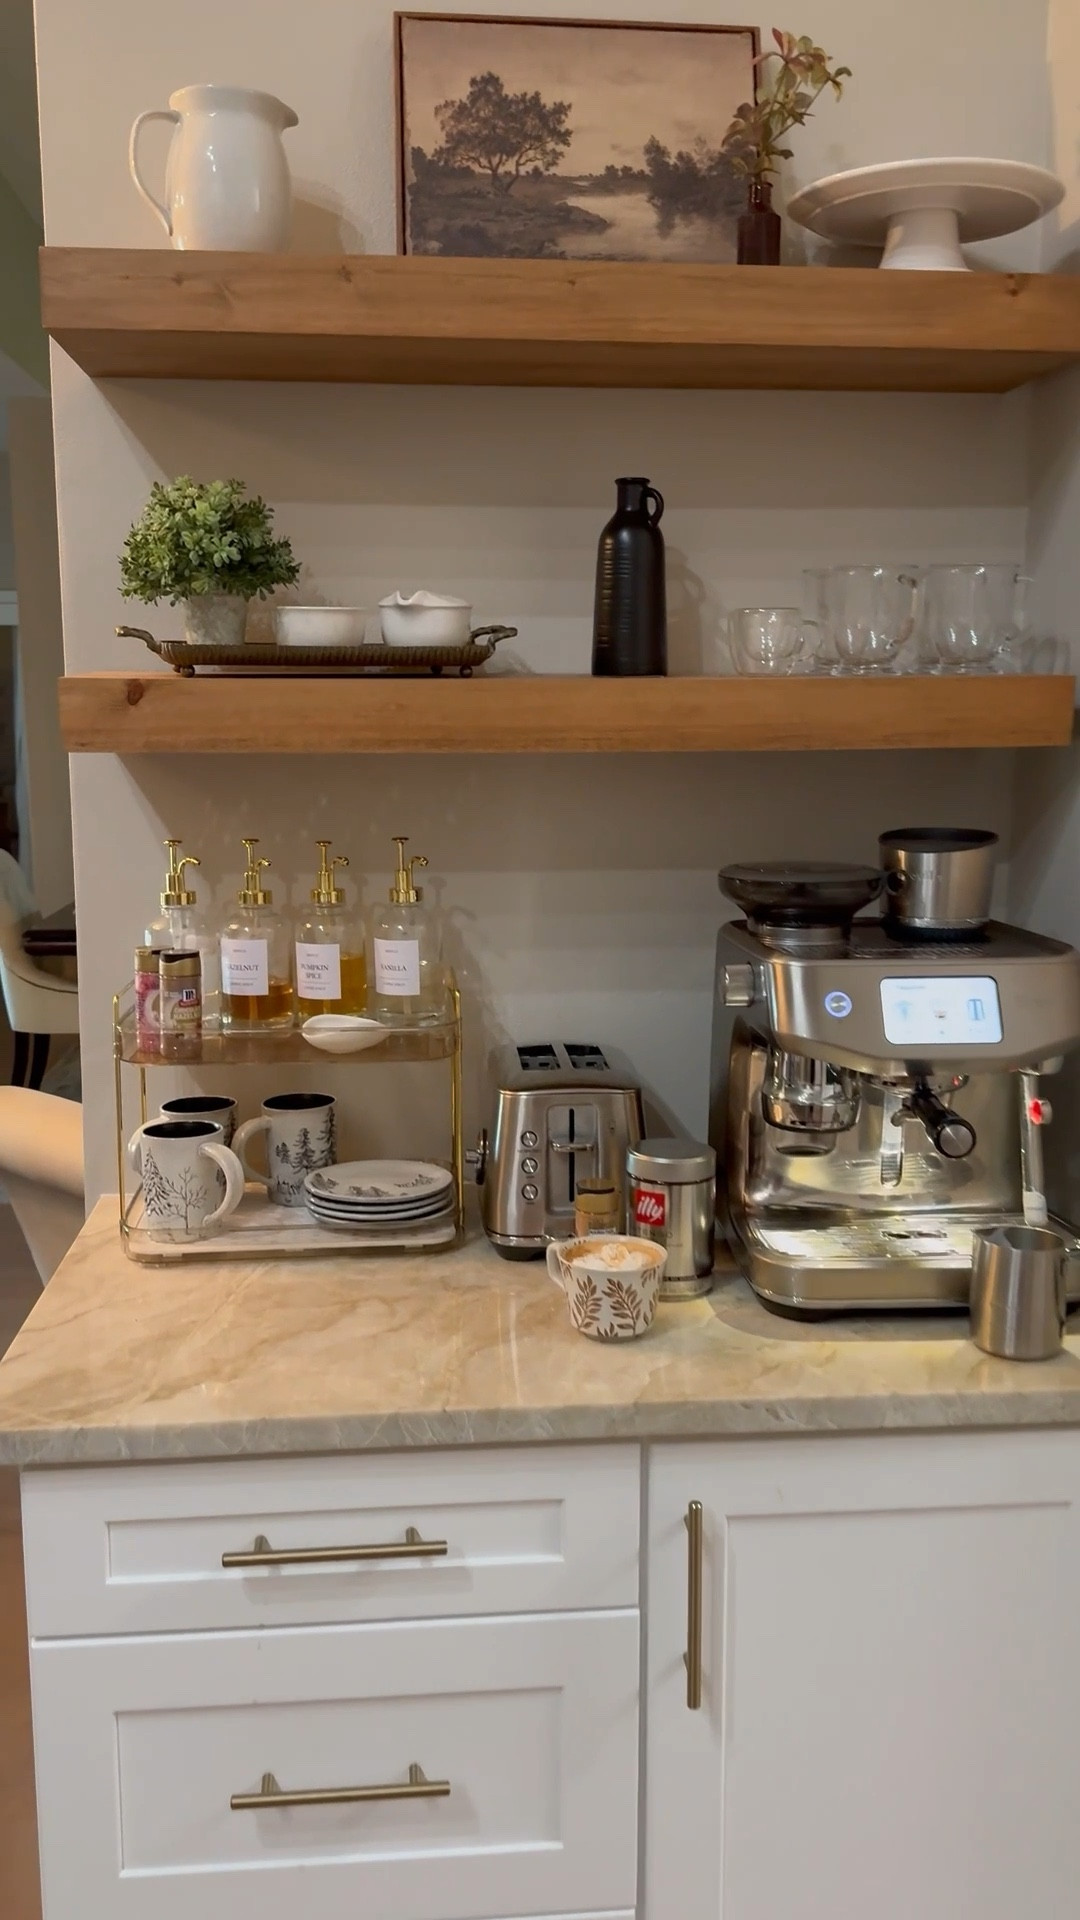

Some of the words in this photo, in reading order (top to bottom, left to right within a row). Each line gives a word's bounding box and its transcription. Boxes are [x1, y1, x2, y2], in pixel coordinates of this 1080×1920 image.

[300, 963, 329, 971] PUMPKIN
[380, 963, 407, 972] VANILLA
[305, 972, 321, 980] SPICE
[637, 1196, 664, 1223] illy
